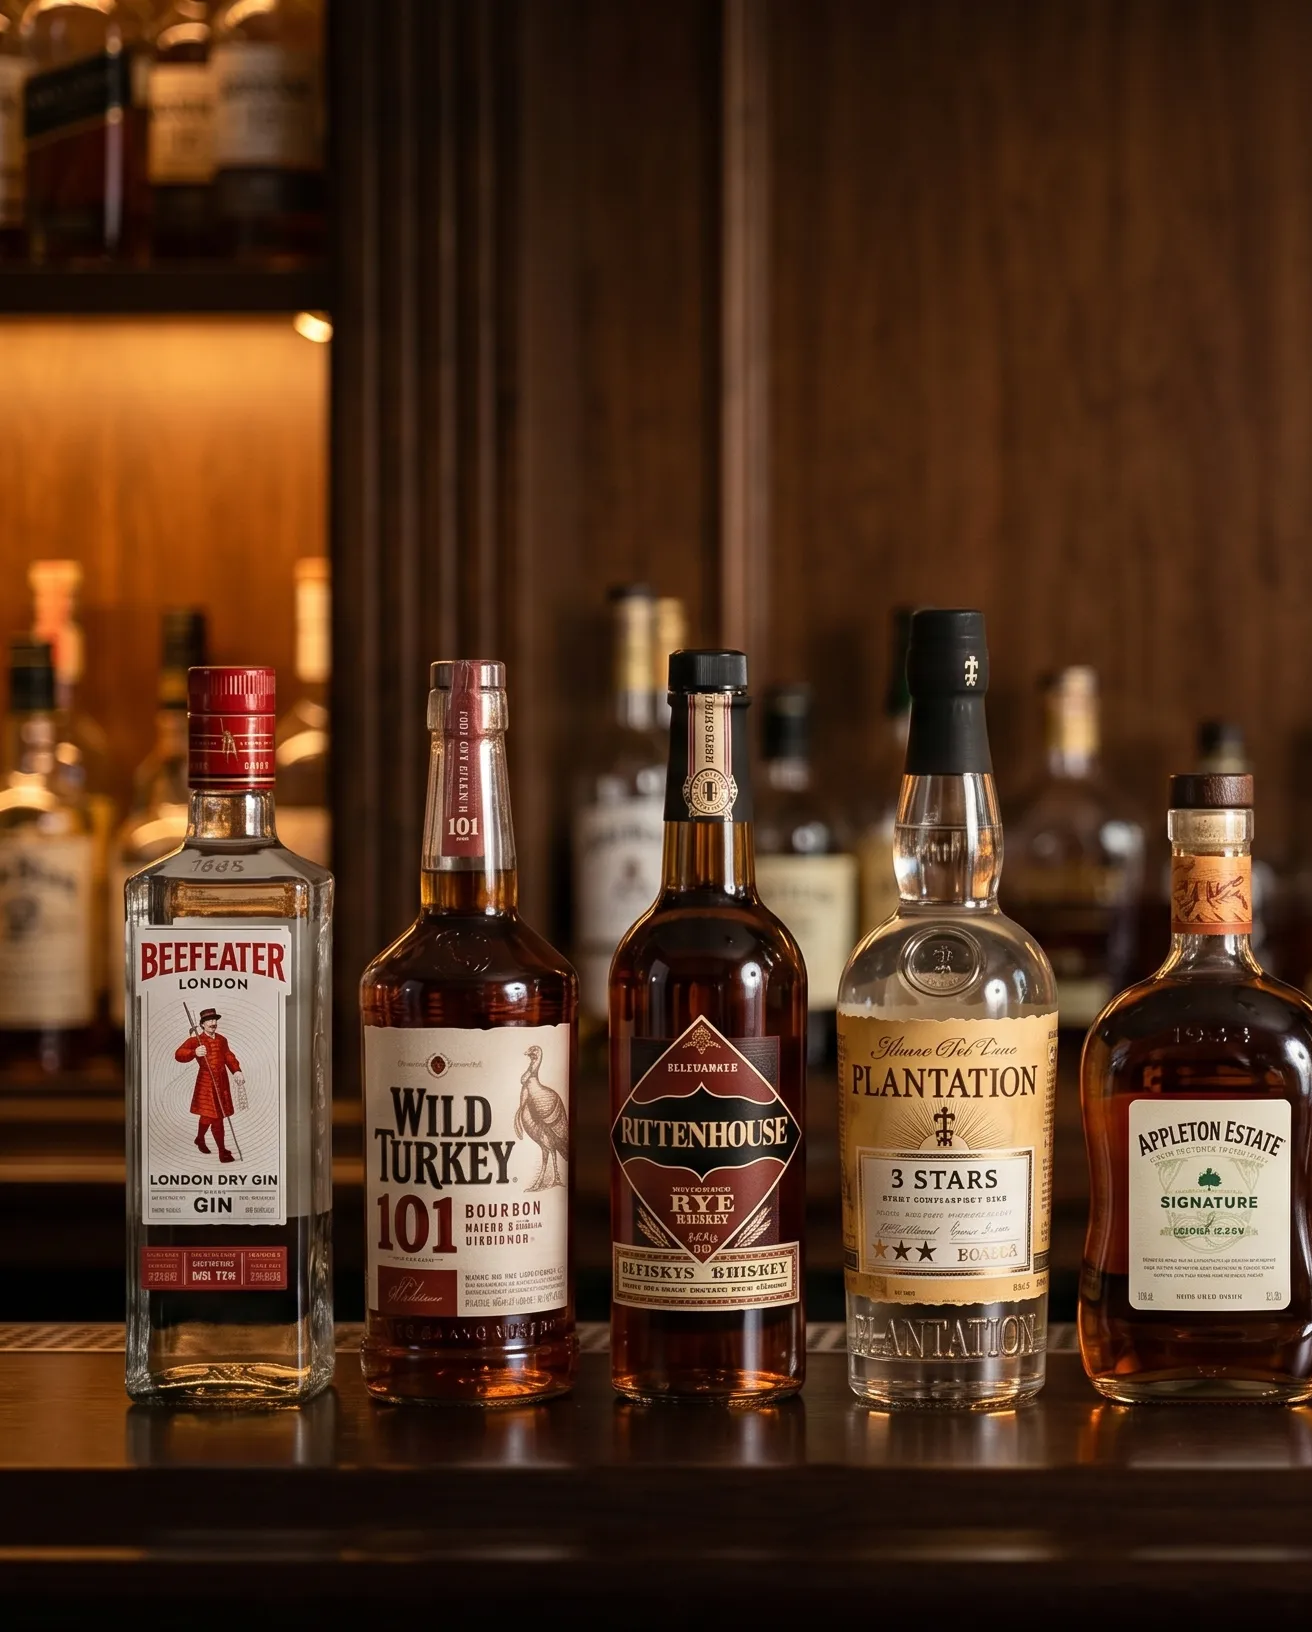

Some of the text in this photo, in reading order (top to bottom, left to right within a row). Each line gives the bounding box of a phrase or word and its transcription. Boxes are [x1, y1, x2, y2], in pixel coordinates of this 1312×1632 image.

[448, 817, 479, 836] 101
[140, 942, 286, 983] BEEFEATER
[178, 977, 248, 990] LONDON
[852, 1064, 1038, 1099] PLANTATION
[621, 1116, 788, 1148] RITTENHOUSE
[1137, 1120, 1221, 1157] APPLETON
[1224, 1120, 1284, 1157] ESTATE
[150, 1174, 278, 1186] LONDON DRY GIN
[891, 1168, 998, 1190] 3 STARS
[193, 1196, 232, 1213] GIN
[465, 1200, 541, 1219] BOURBON
[669, 1194, 735, 1213] RYE
[1160, 1196, 1258, 1209] SIGNATURE
[377, 1193, 458, 1254] 101
